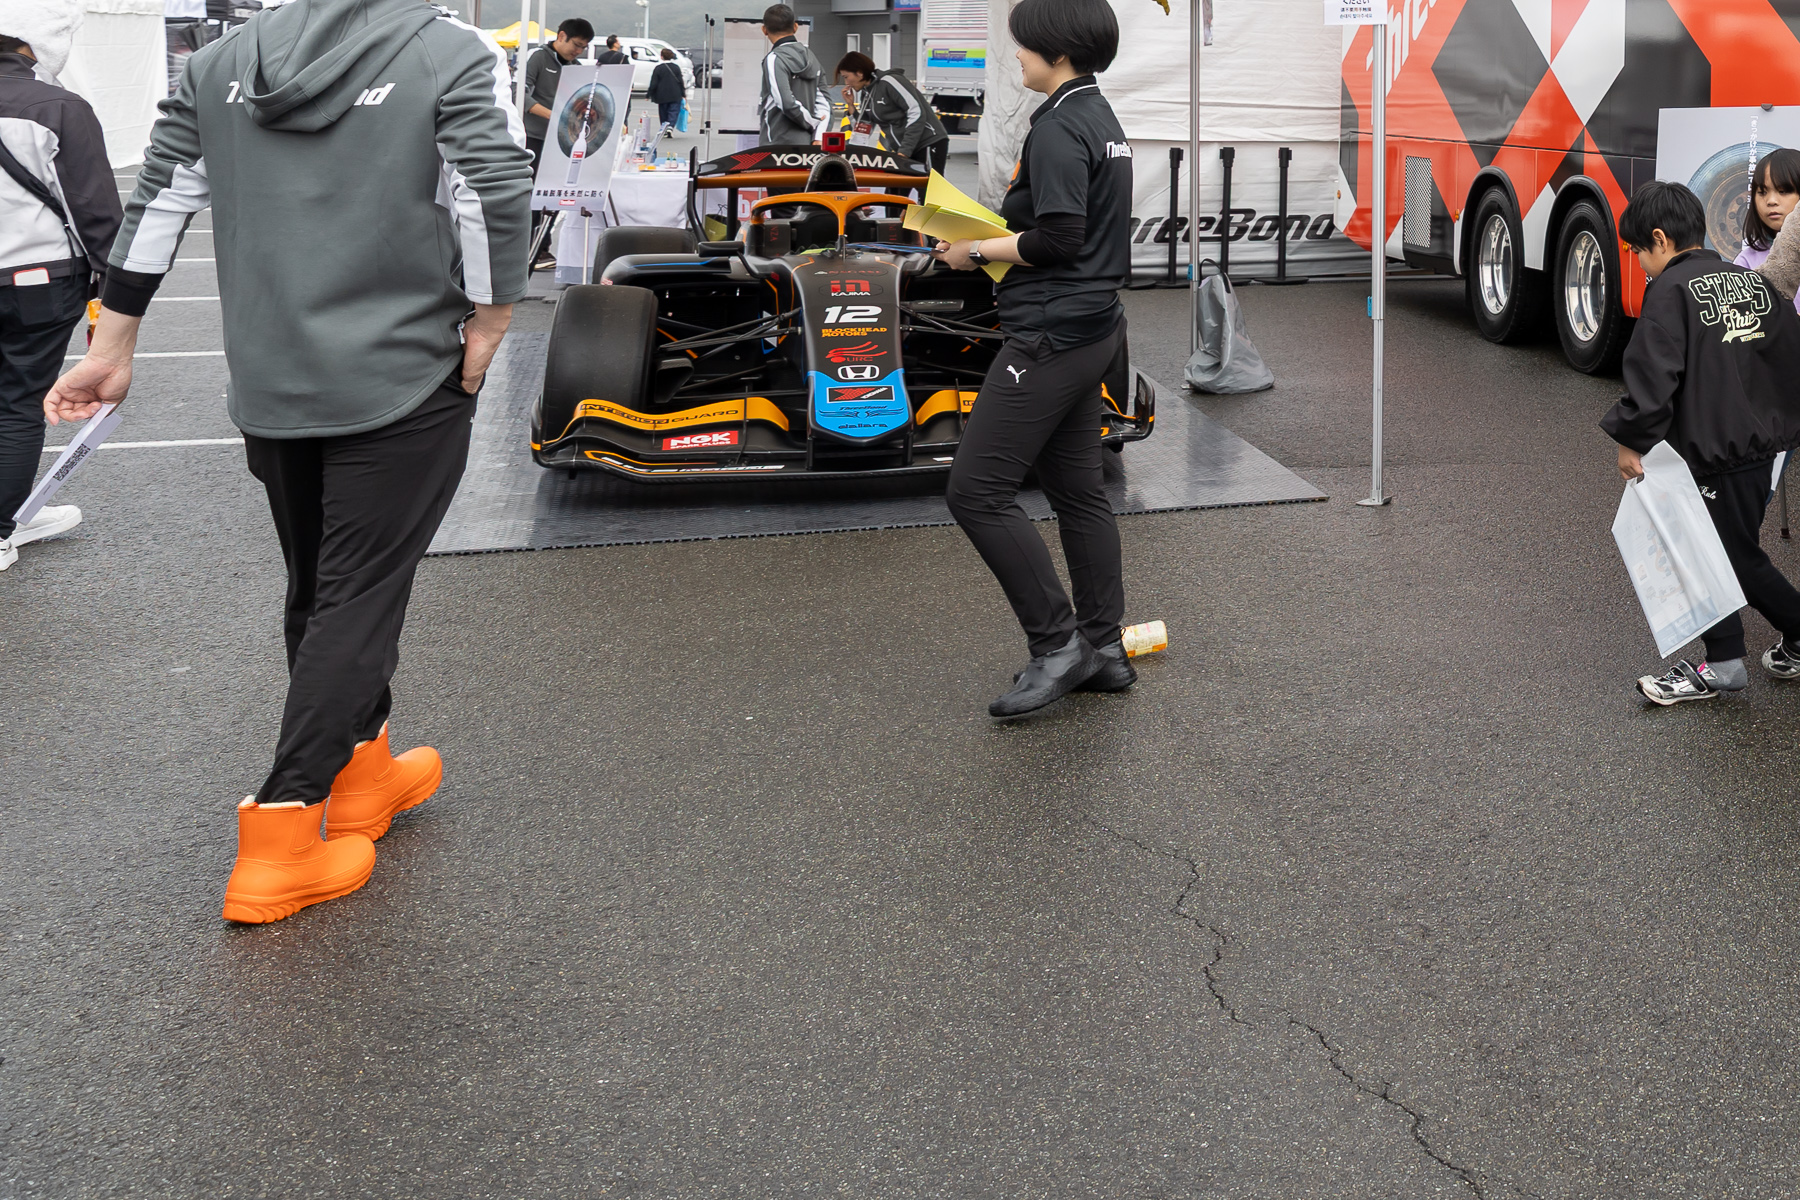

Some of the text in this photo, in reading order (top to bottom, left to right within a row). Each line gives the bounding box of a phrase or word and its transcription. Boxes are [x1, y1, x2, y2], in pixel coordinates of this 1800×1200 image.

[771, 153, 899, 170] YOKAMA
[1688, 271, 1772, 326] STARS
[823, 305, 883, 324] 12
[580, 403, 739, 425] INTERIOR GUARD
[670, 432, 732, 446] NGK
[703, 440, 732, 448] PLUGS
